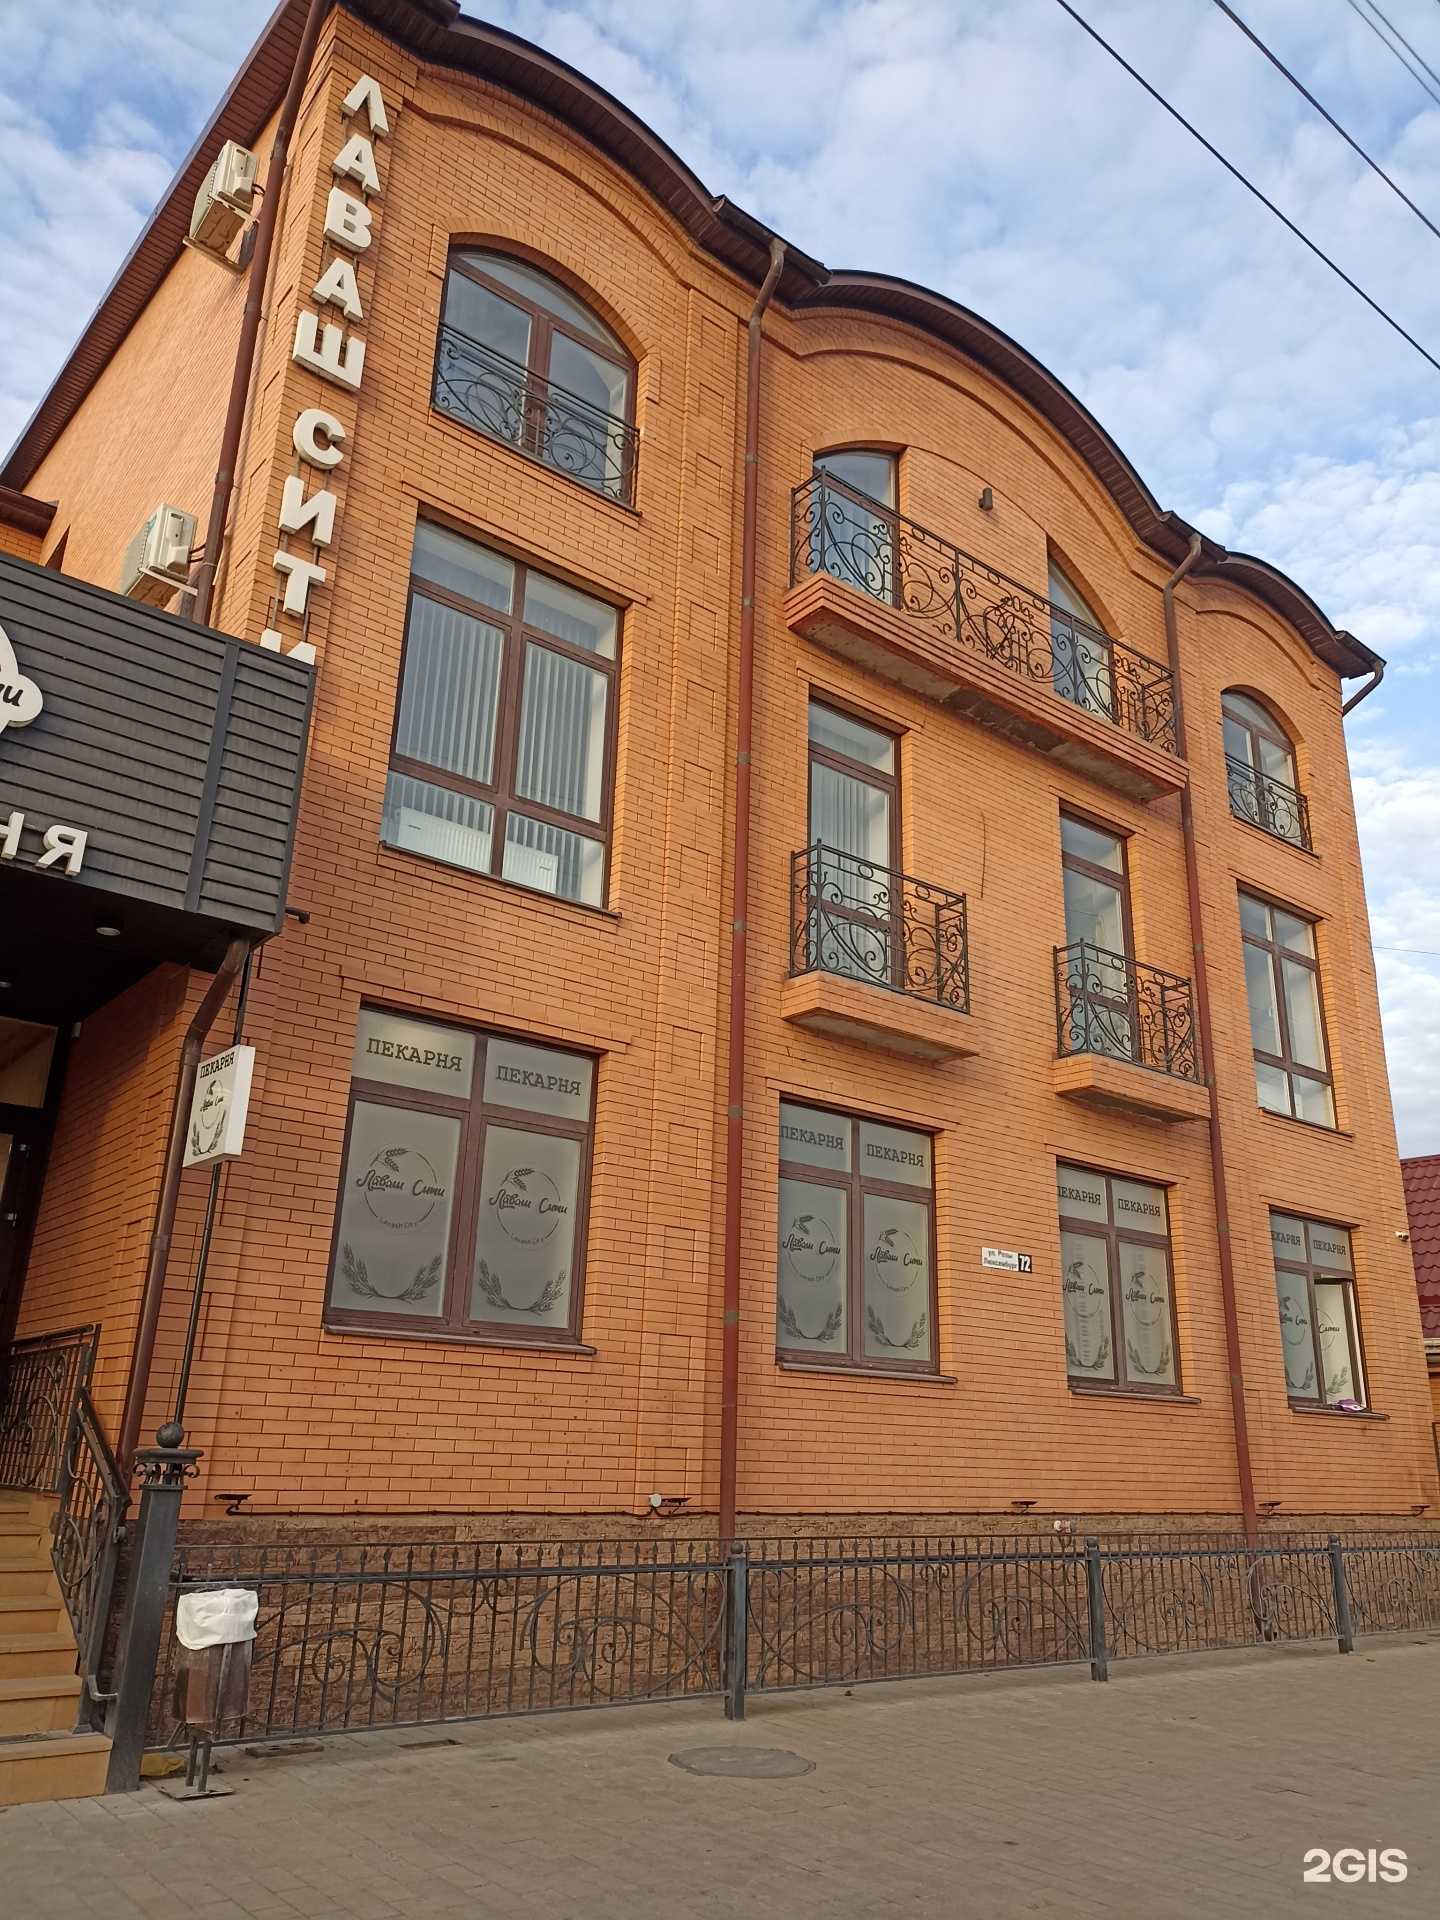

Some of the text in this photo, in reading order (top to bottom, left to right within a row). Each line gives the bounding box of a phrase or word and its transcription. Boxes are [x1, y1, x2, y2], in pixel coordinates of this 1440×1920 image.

[292, 74, 390, 391] ЛАВАШ
[200, 1051, 235, 1079] ПЕКАРНЯ
[366, 1038, 463, 1072] ПЕКАРНЯ
[495, 1065, 582, 1096] ПЕКАРНЯ
[780, 1126, 844, 1150] ПЕКАРНЯ
[866, 1143, 925, 1168] ПЕКАРНЯ
[356, 1169, 445, 1197] Лаваш Сити
[489, 1188, 568, 1214] Лаваш Сити
[1118, 1198, 1161, 1217] ПЕКАРНЯ
[1019, 1255, 1031, 1272] 72
